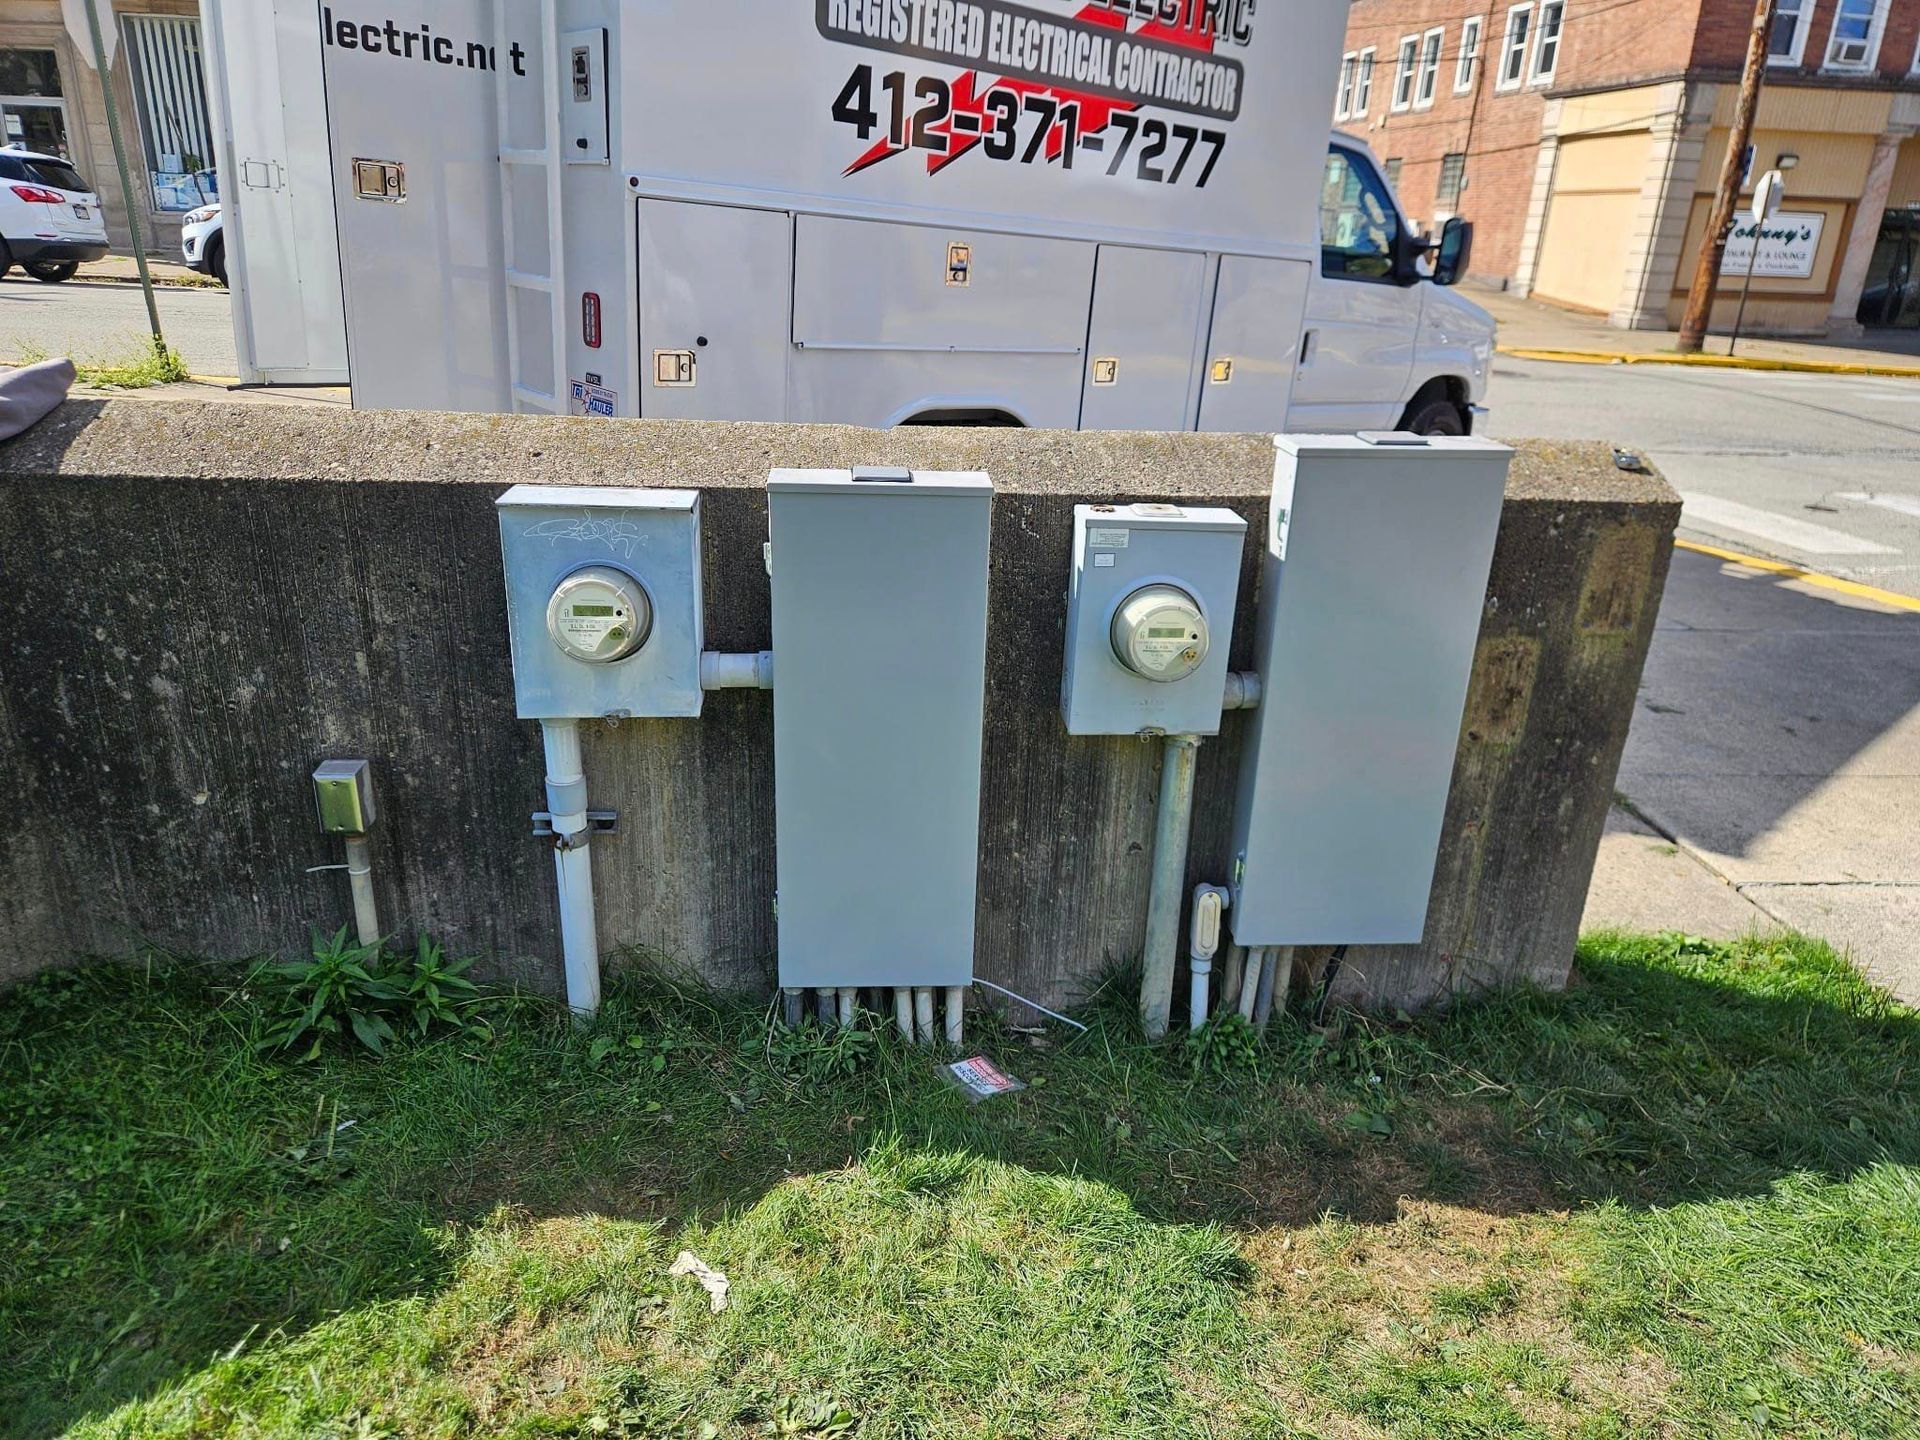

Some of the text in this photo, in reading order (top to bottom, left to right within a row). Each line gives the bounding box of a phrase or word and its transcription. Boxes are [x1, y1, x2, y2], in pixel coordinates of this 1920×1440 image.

[828, 0, 1238, 113] REGISTERED ELECTRICAL CONTRACTOR
[831, 64, 1227, 188] 412-371-7277
